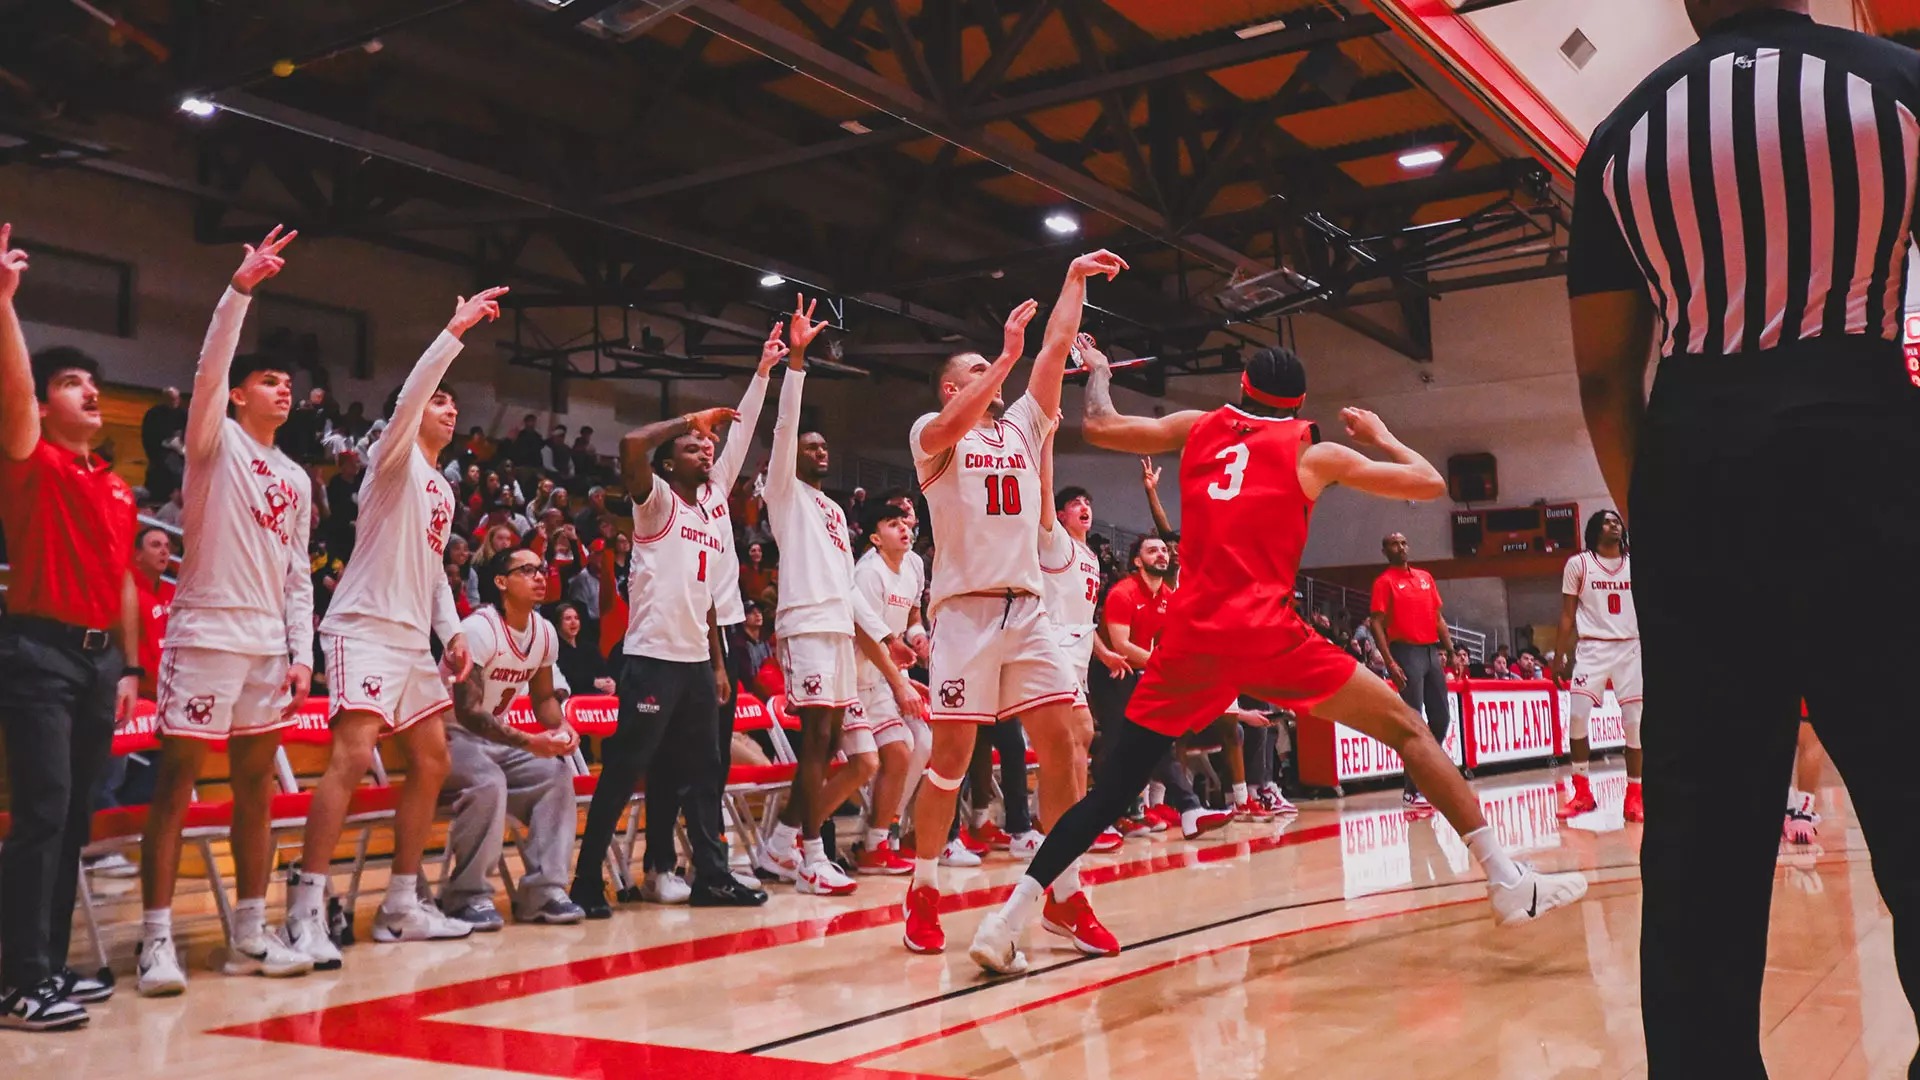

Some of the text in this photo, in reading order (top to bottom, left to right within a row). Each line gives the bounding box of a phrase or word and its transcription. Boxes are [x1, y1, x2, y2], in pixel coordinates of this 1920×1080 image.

[1207, 442, 1250, 501] 3
[985, 474, 1022, 515] 10
[697, 550, 707, 582] 1
[1607, 594, 1621, 615] 0
[1476, 699, 1551, 754] ORTLAND
[1341, 737, 1371, 775] RED
